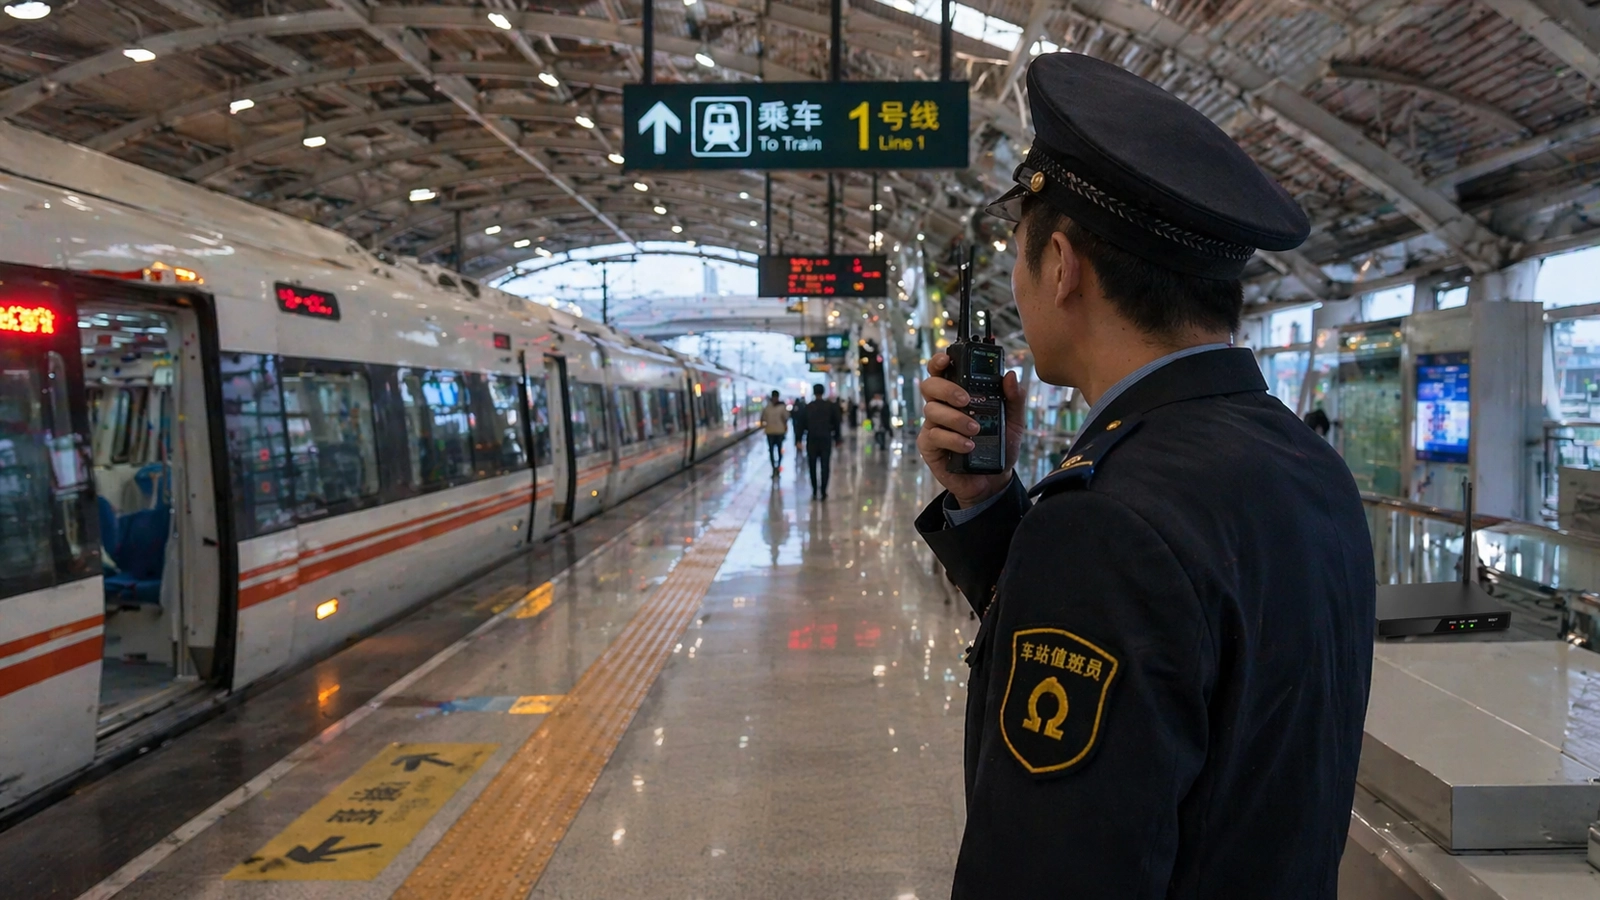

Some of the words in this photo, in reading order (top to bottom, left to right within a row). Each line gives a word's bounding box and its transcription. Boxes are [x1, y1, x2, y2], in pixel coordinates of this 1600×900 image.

[758, 100, 823, 132] 乘车
[849, 101, 870, 151] 1
[878, 100, 940, 131] 号线
[758, 135, 779, 151] To
[782, 135, 822, 151] Train
[879, 135, 913, 151] Line
[917, 135, 925, 150] 1
[1021, 641, 1102, 682] 车站值班员
